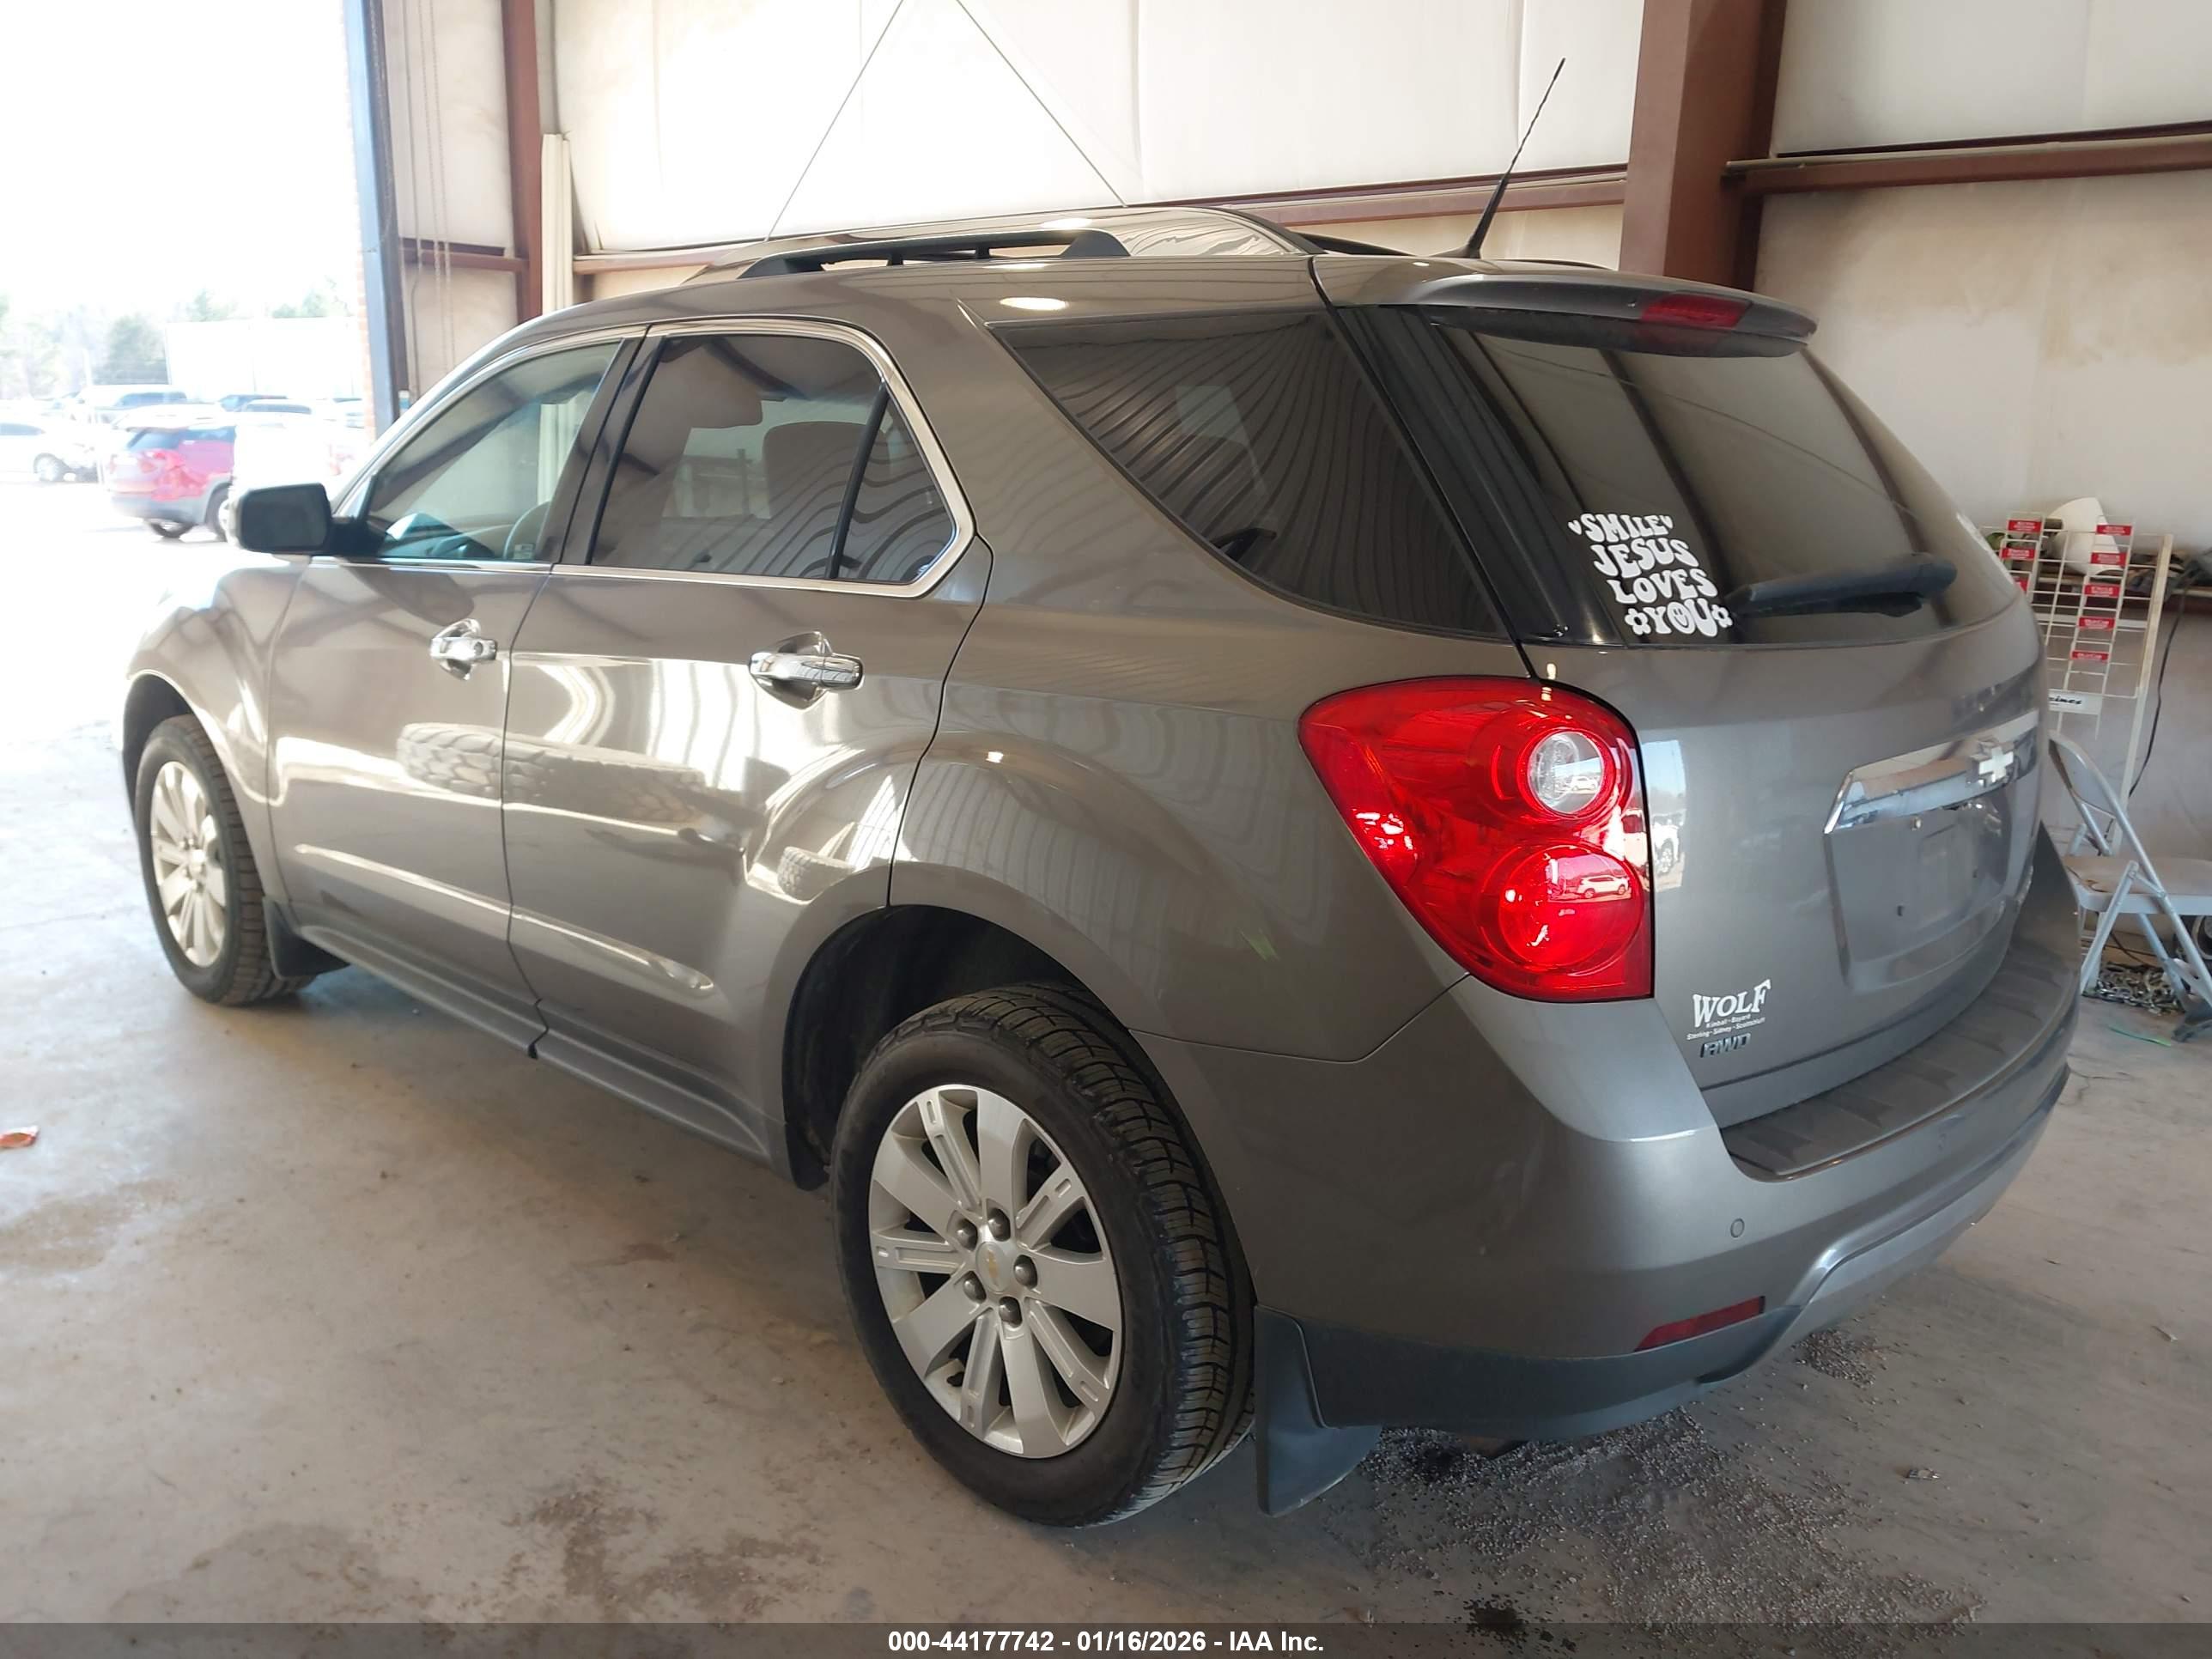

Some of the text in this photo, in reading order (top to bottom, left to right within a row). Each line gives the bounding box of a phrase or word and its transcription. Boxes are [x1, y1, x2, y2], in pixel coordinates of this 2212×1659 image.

[1581, 514, 1668, 542] SMILE
[1590, 538, 1699, 578] JESUS
[1607, 568, 1718, 604] LOVES
[1644, 599, 1717, 637] YOU
[1692, 979, 1771, 1027] WOLF
